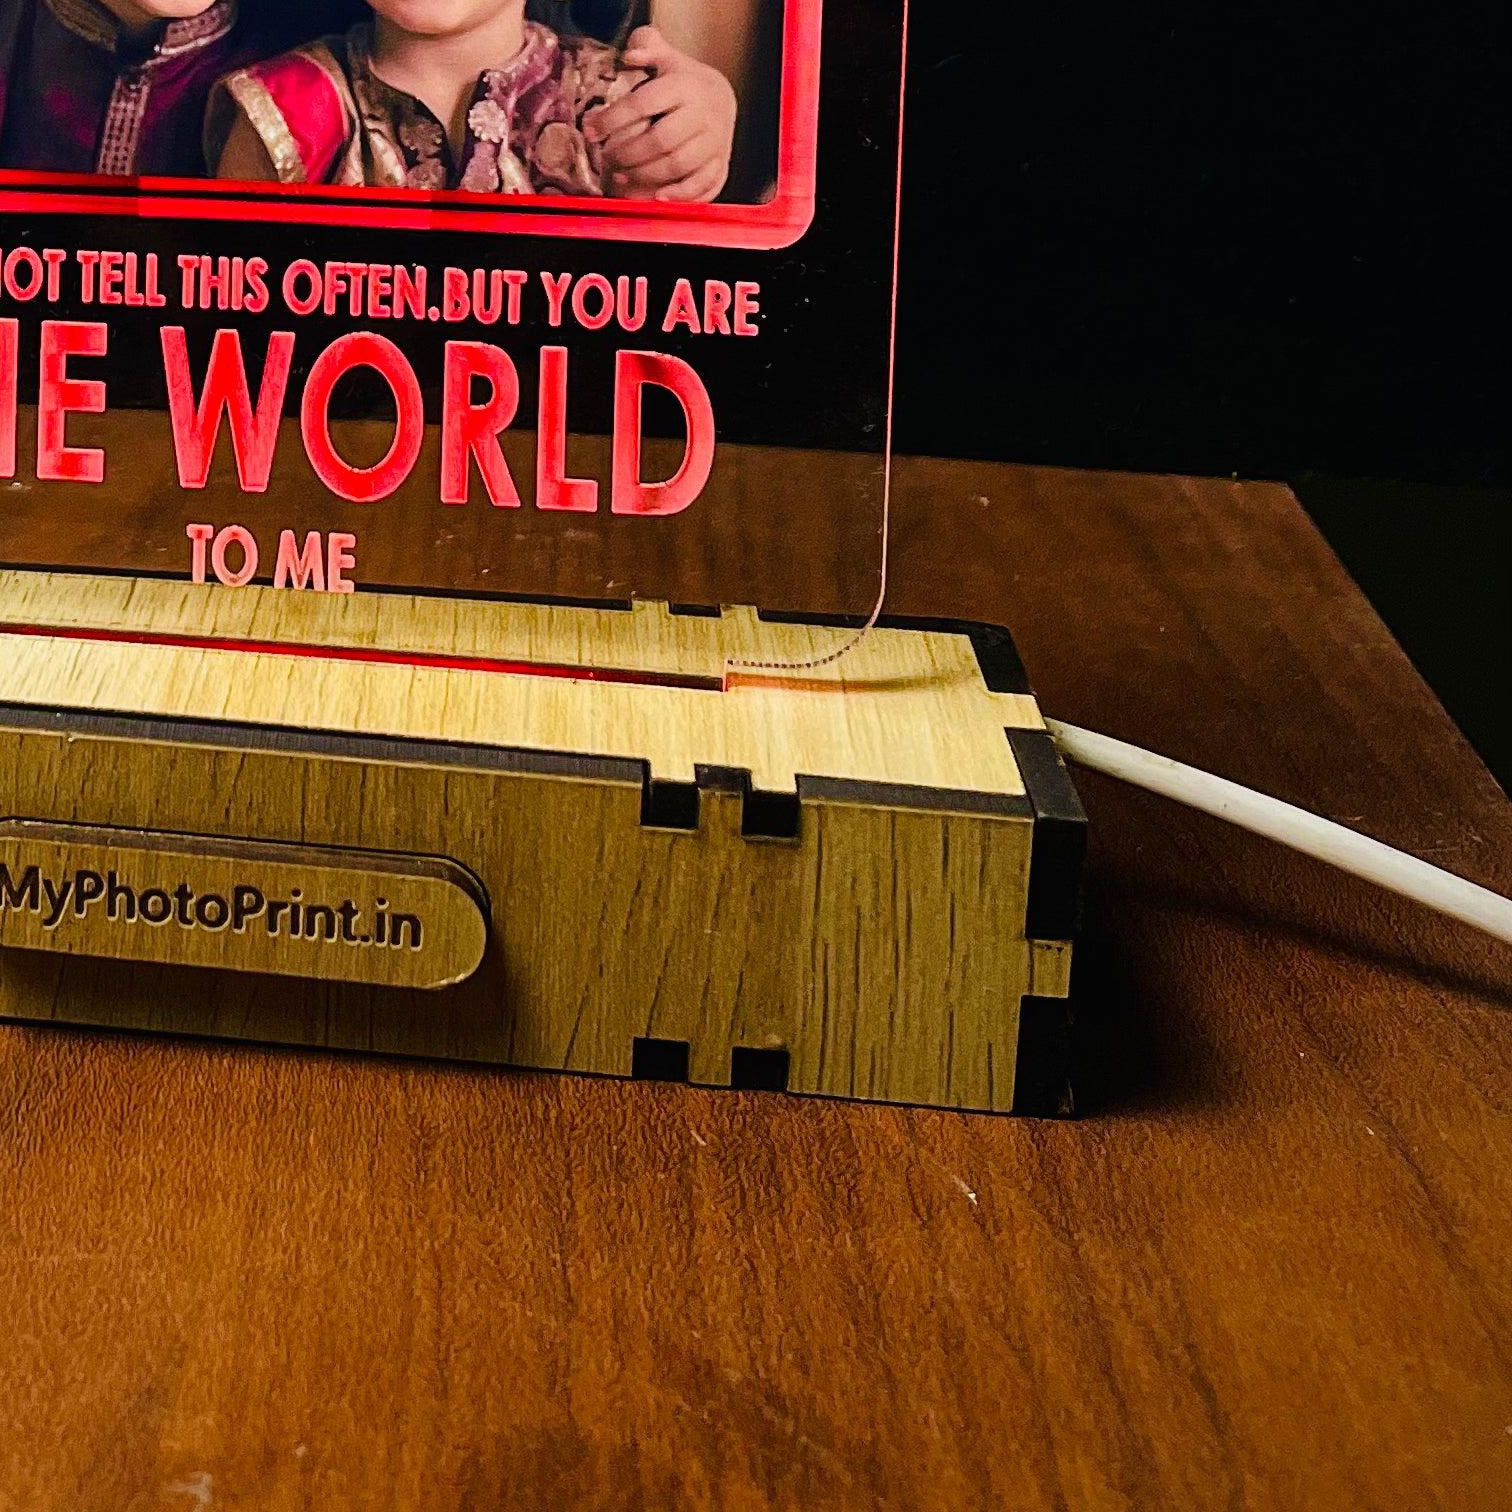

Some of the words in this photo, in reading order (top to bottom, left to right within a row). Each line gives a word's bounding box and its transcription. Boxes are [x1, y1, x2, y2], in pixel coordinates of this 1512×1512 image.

[77, 250, 166, 308] TELL
[177, 254, 268, 314] THIS
[540, 271, 648, 331] YOU
[663, 277, 761, 337] ARE
[160, 324, 716, 516] WORLD
[186, 523, 259, 588] TO
[274, 529, 356, 594] ME
